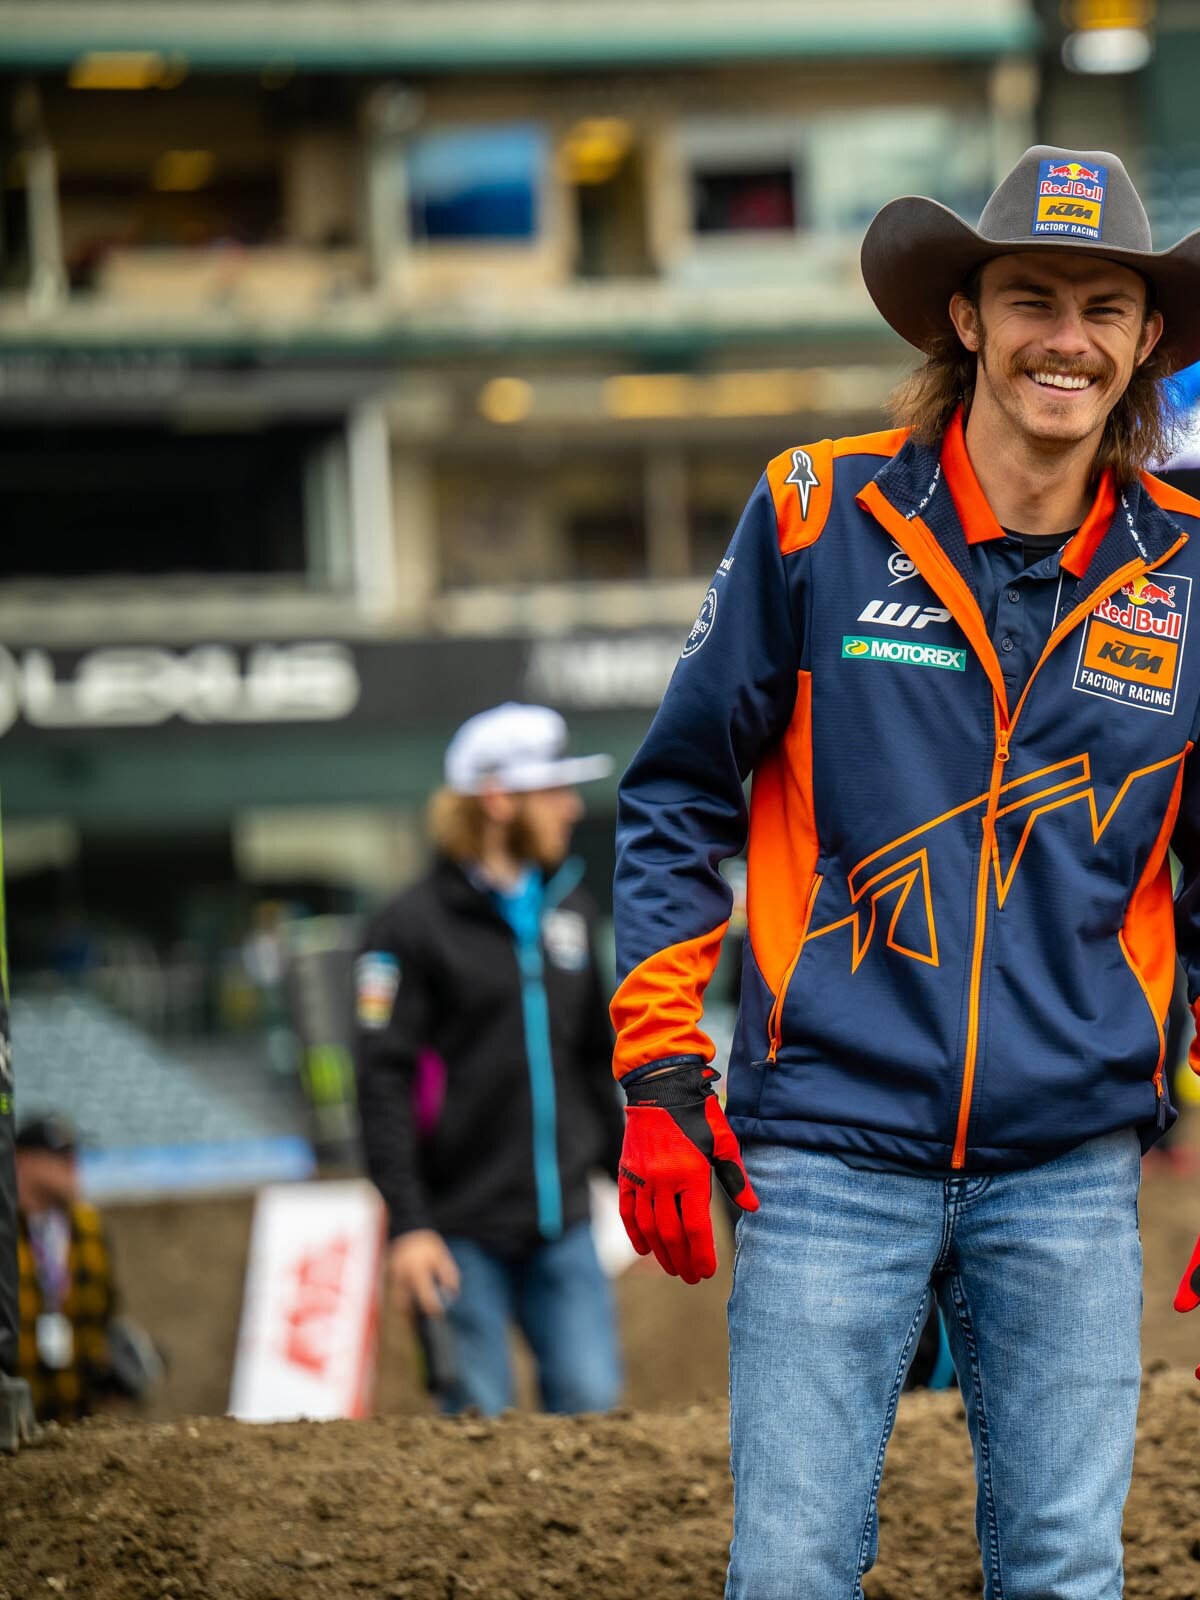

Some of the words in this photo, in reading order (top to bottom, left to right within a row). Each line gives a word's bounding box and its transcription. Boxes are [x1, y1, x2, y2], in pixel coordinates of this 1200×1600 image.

[1040, 181, 1073, 195] Red
[1073, 182, 1103, 201] Bull
[1046, 203, 1093, 219] KTM
[1035, 223, 1069, 232] FACTORY
[1071, 225, 1098, 238] RACING
[857, 600, 952, 630] WP
[1094, 597, 1134, 629] Red
[1134, 607, 1181, 639] Bull
[871, 641, 960, 668] MOTOREX
[1097, 640, 1164, 674] KTM
[1080, 670, 1126, 696] FACTORY
[1129, 685, 1171, 706] RACING
